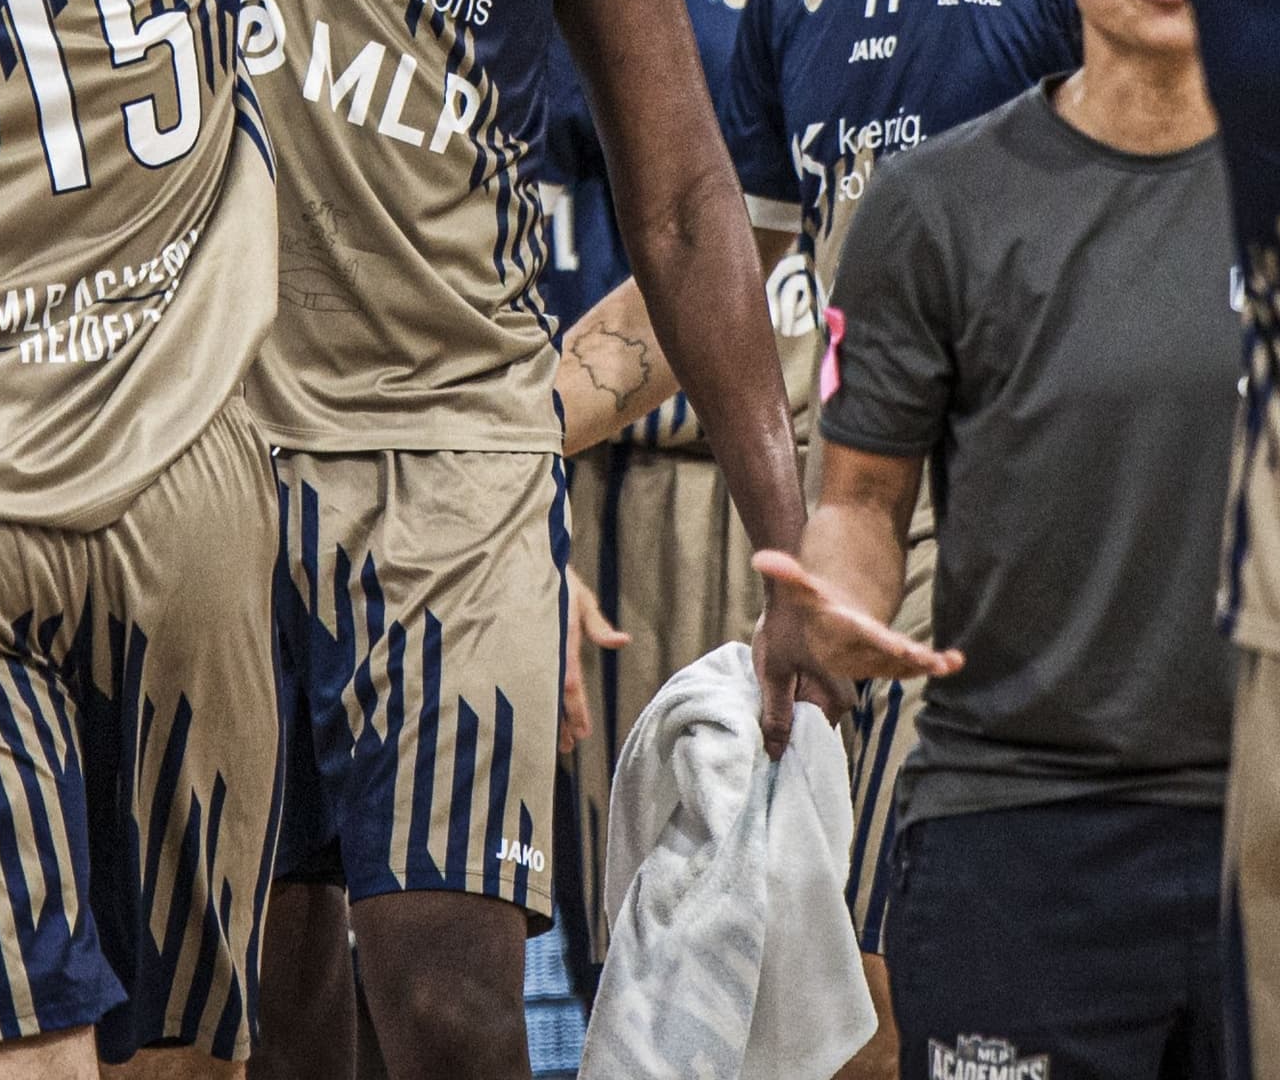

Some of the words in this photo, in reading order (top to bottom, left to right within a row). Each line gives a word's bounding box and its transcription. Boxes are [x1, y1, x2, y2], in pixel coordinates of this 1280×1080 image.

[848, 35, 898, 63] JAKO
[303, 19, 480, 155] MLP
[496, 838, 545, 873] JAKO
